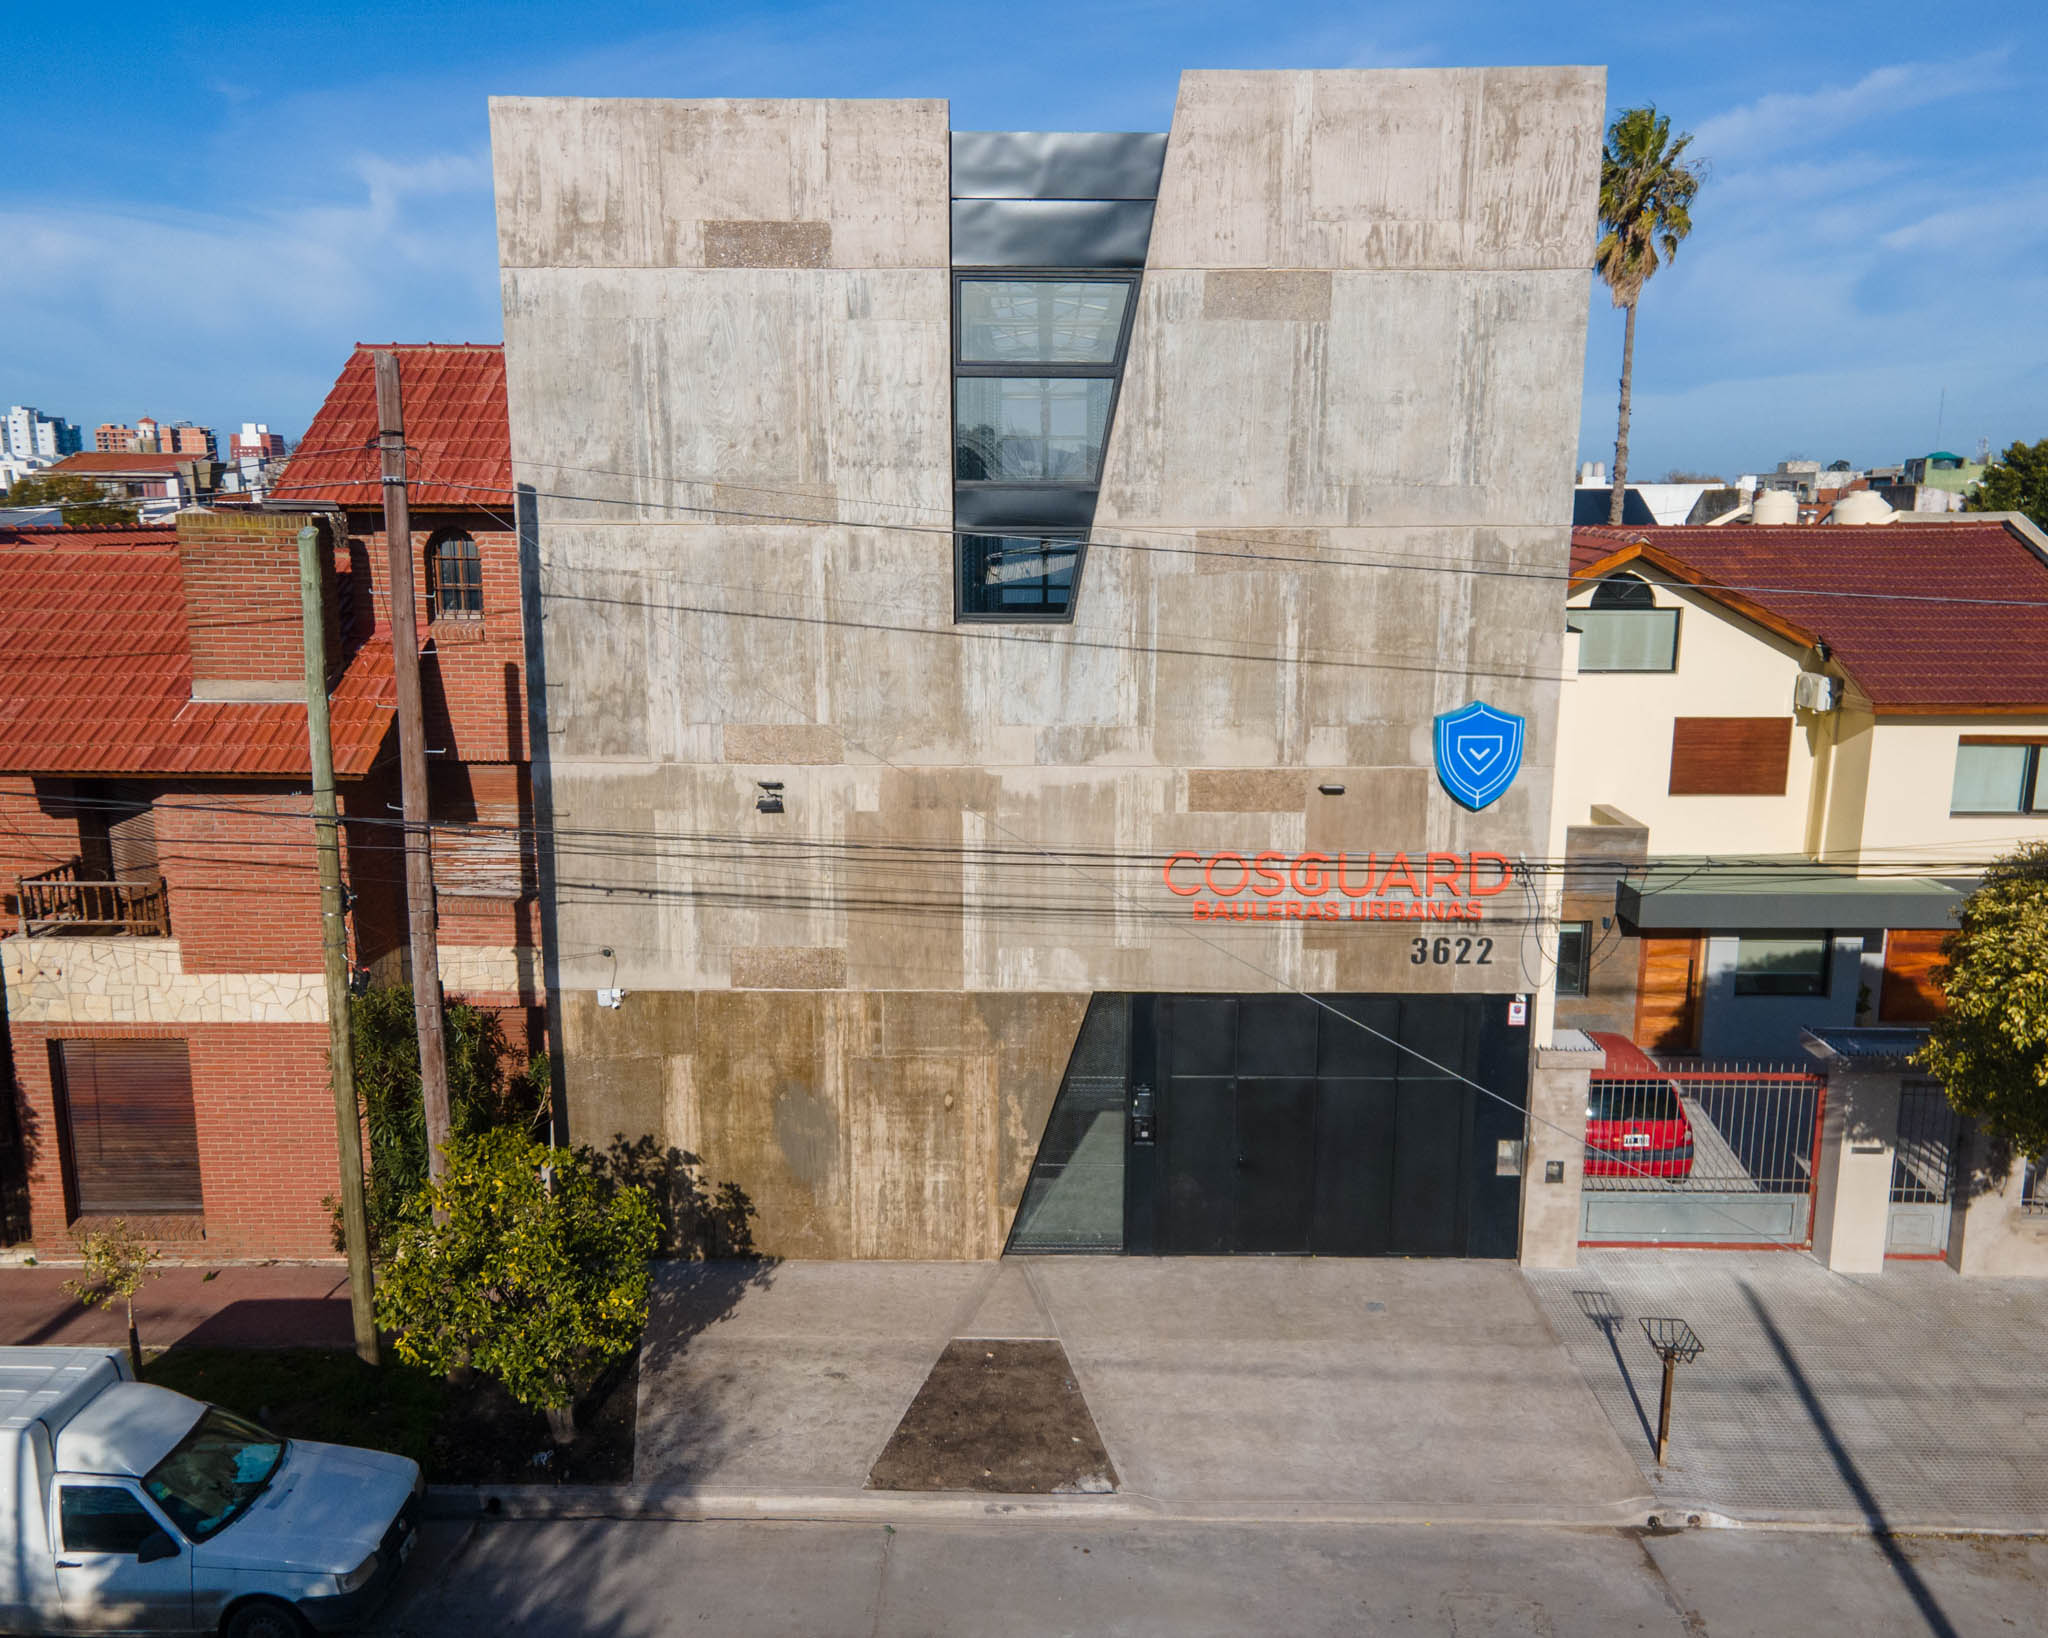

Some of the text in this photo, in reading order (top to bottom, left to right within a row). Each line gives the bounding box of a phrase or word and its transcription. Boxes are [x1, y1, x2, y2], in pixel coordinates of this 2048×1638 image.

[1162, 850, 1513, 897] COSGUARD
[1192, 900, 1483, 921] BAULERAS URBANAS
[1410, 937, 1494, 965] 3622
